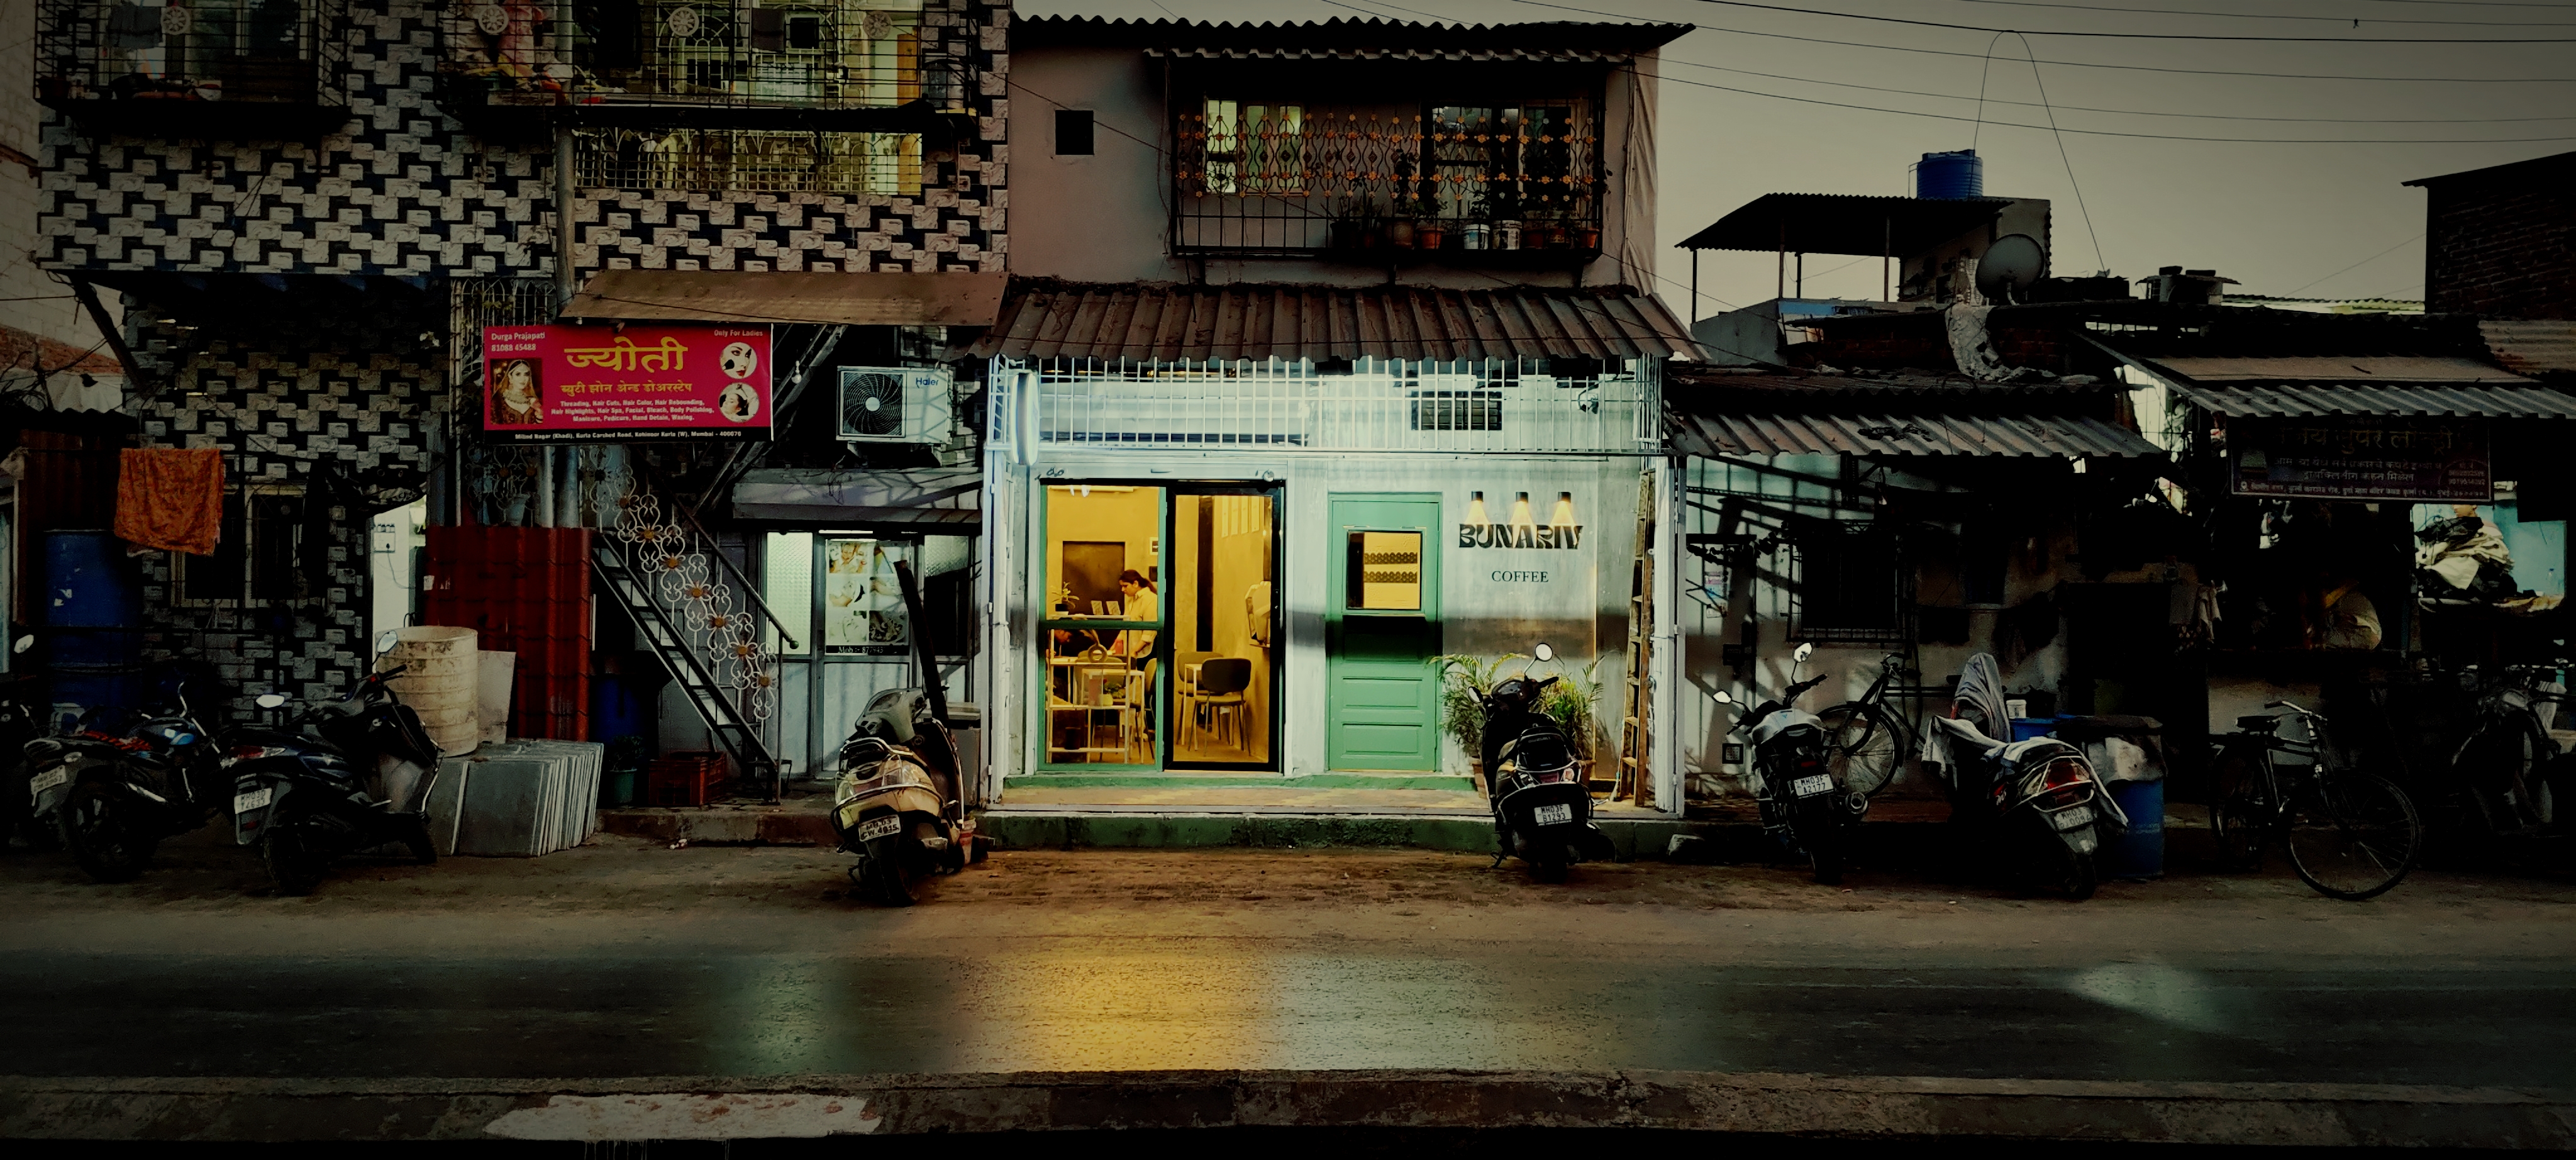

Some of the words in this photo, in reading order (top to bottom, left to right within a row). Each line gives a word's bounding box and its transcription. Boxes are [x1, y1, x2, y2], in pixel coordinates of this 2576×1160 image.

[491, 333, 513, 342] Durga
[514, 331, 545, 341] Prajapati
[564, 336, 689, 373] ज्योती
[1492, 571, 1548, 583] COFFEE
